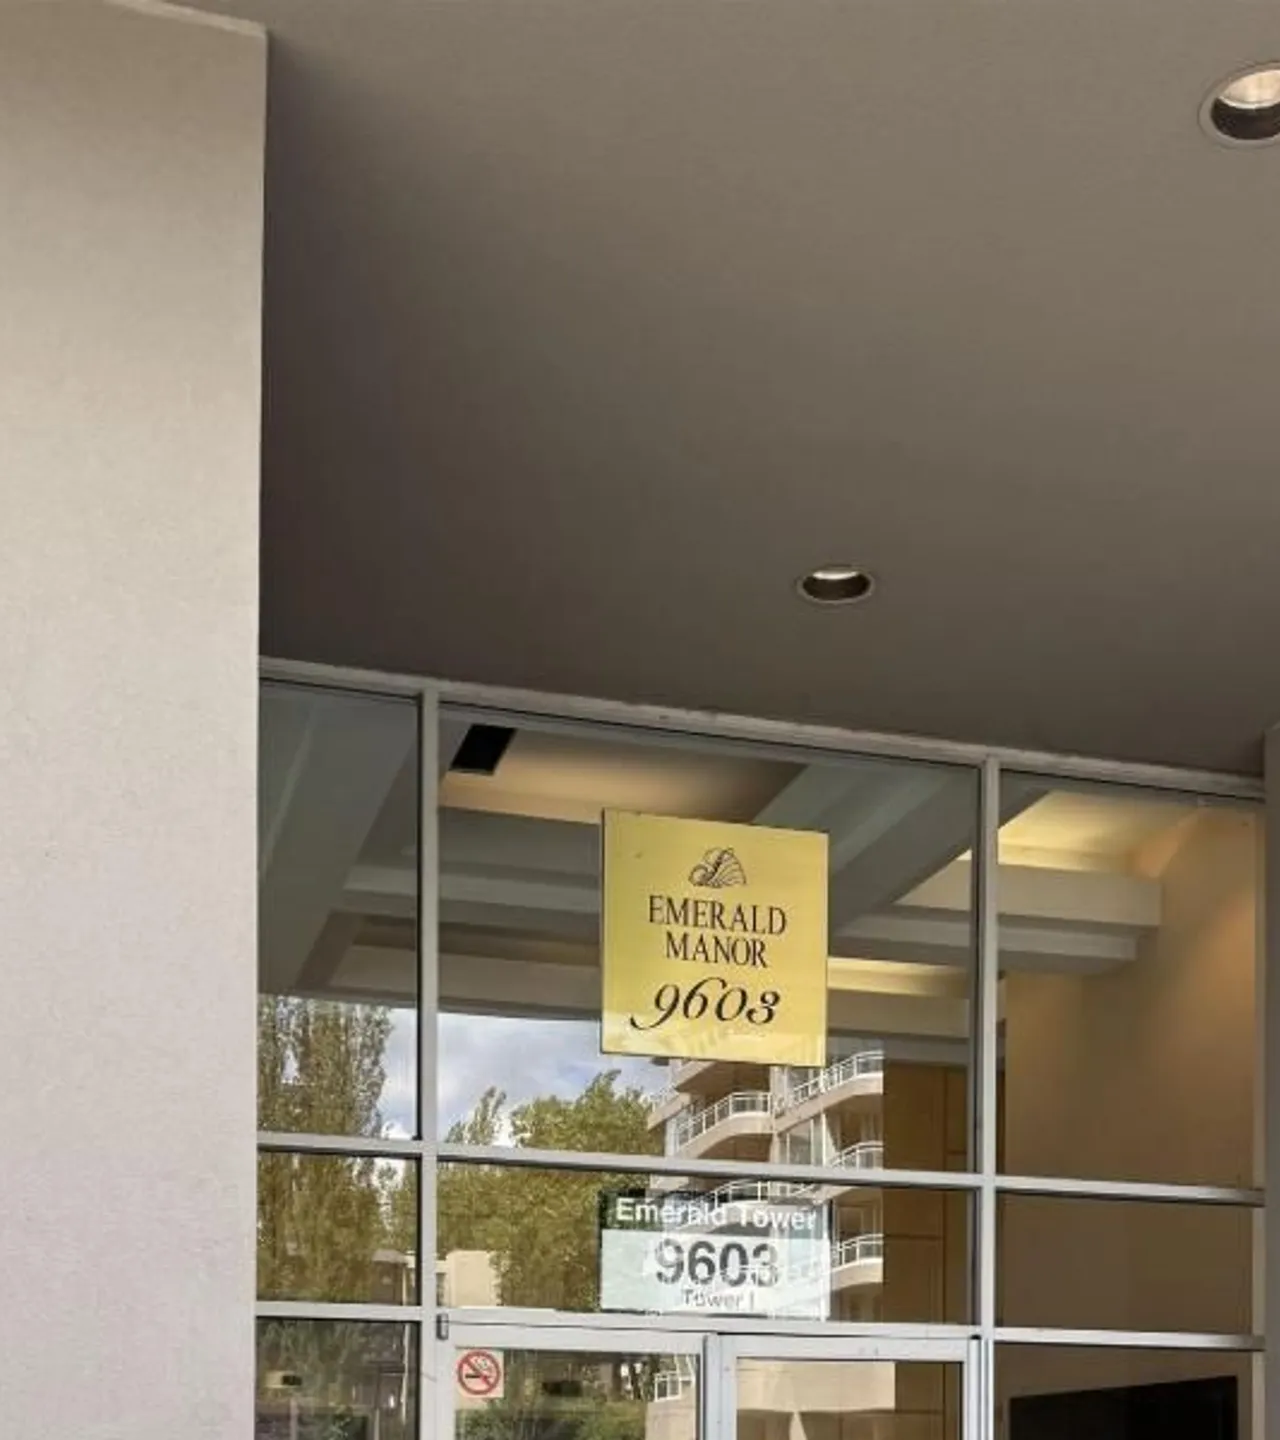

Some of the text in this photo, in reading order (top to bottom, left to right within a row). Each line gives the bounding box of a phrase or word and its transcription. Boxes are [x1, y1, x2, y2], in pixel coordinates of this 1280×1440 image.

[649, 895, 787, 936] EMERALD
[666, 932, 768, 969] MANOR
[630, 977, 781, 1031] 9603
[616, 1197, 816, 1230] Emerald Tower
[655, 1238, 778, 1287] 9603
[683, 1288, 742, 1308] Tower
